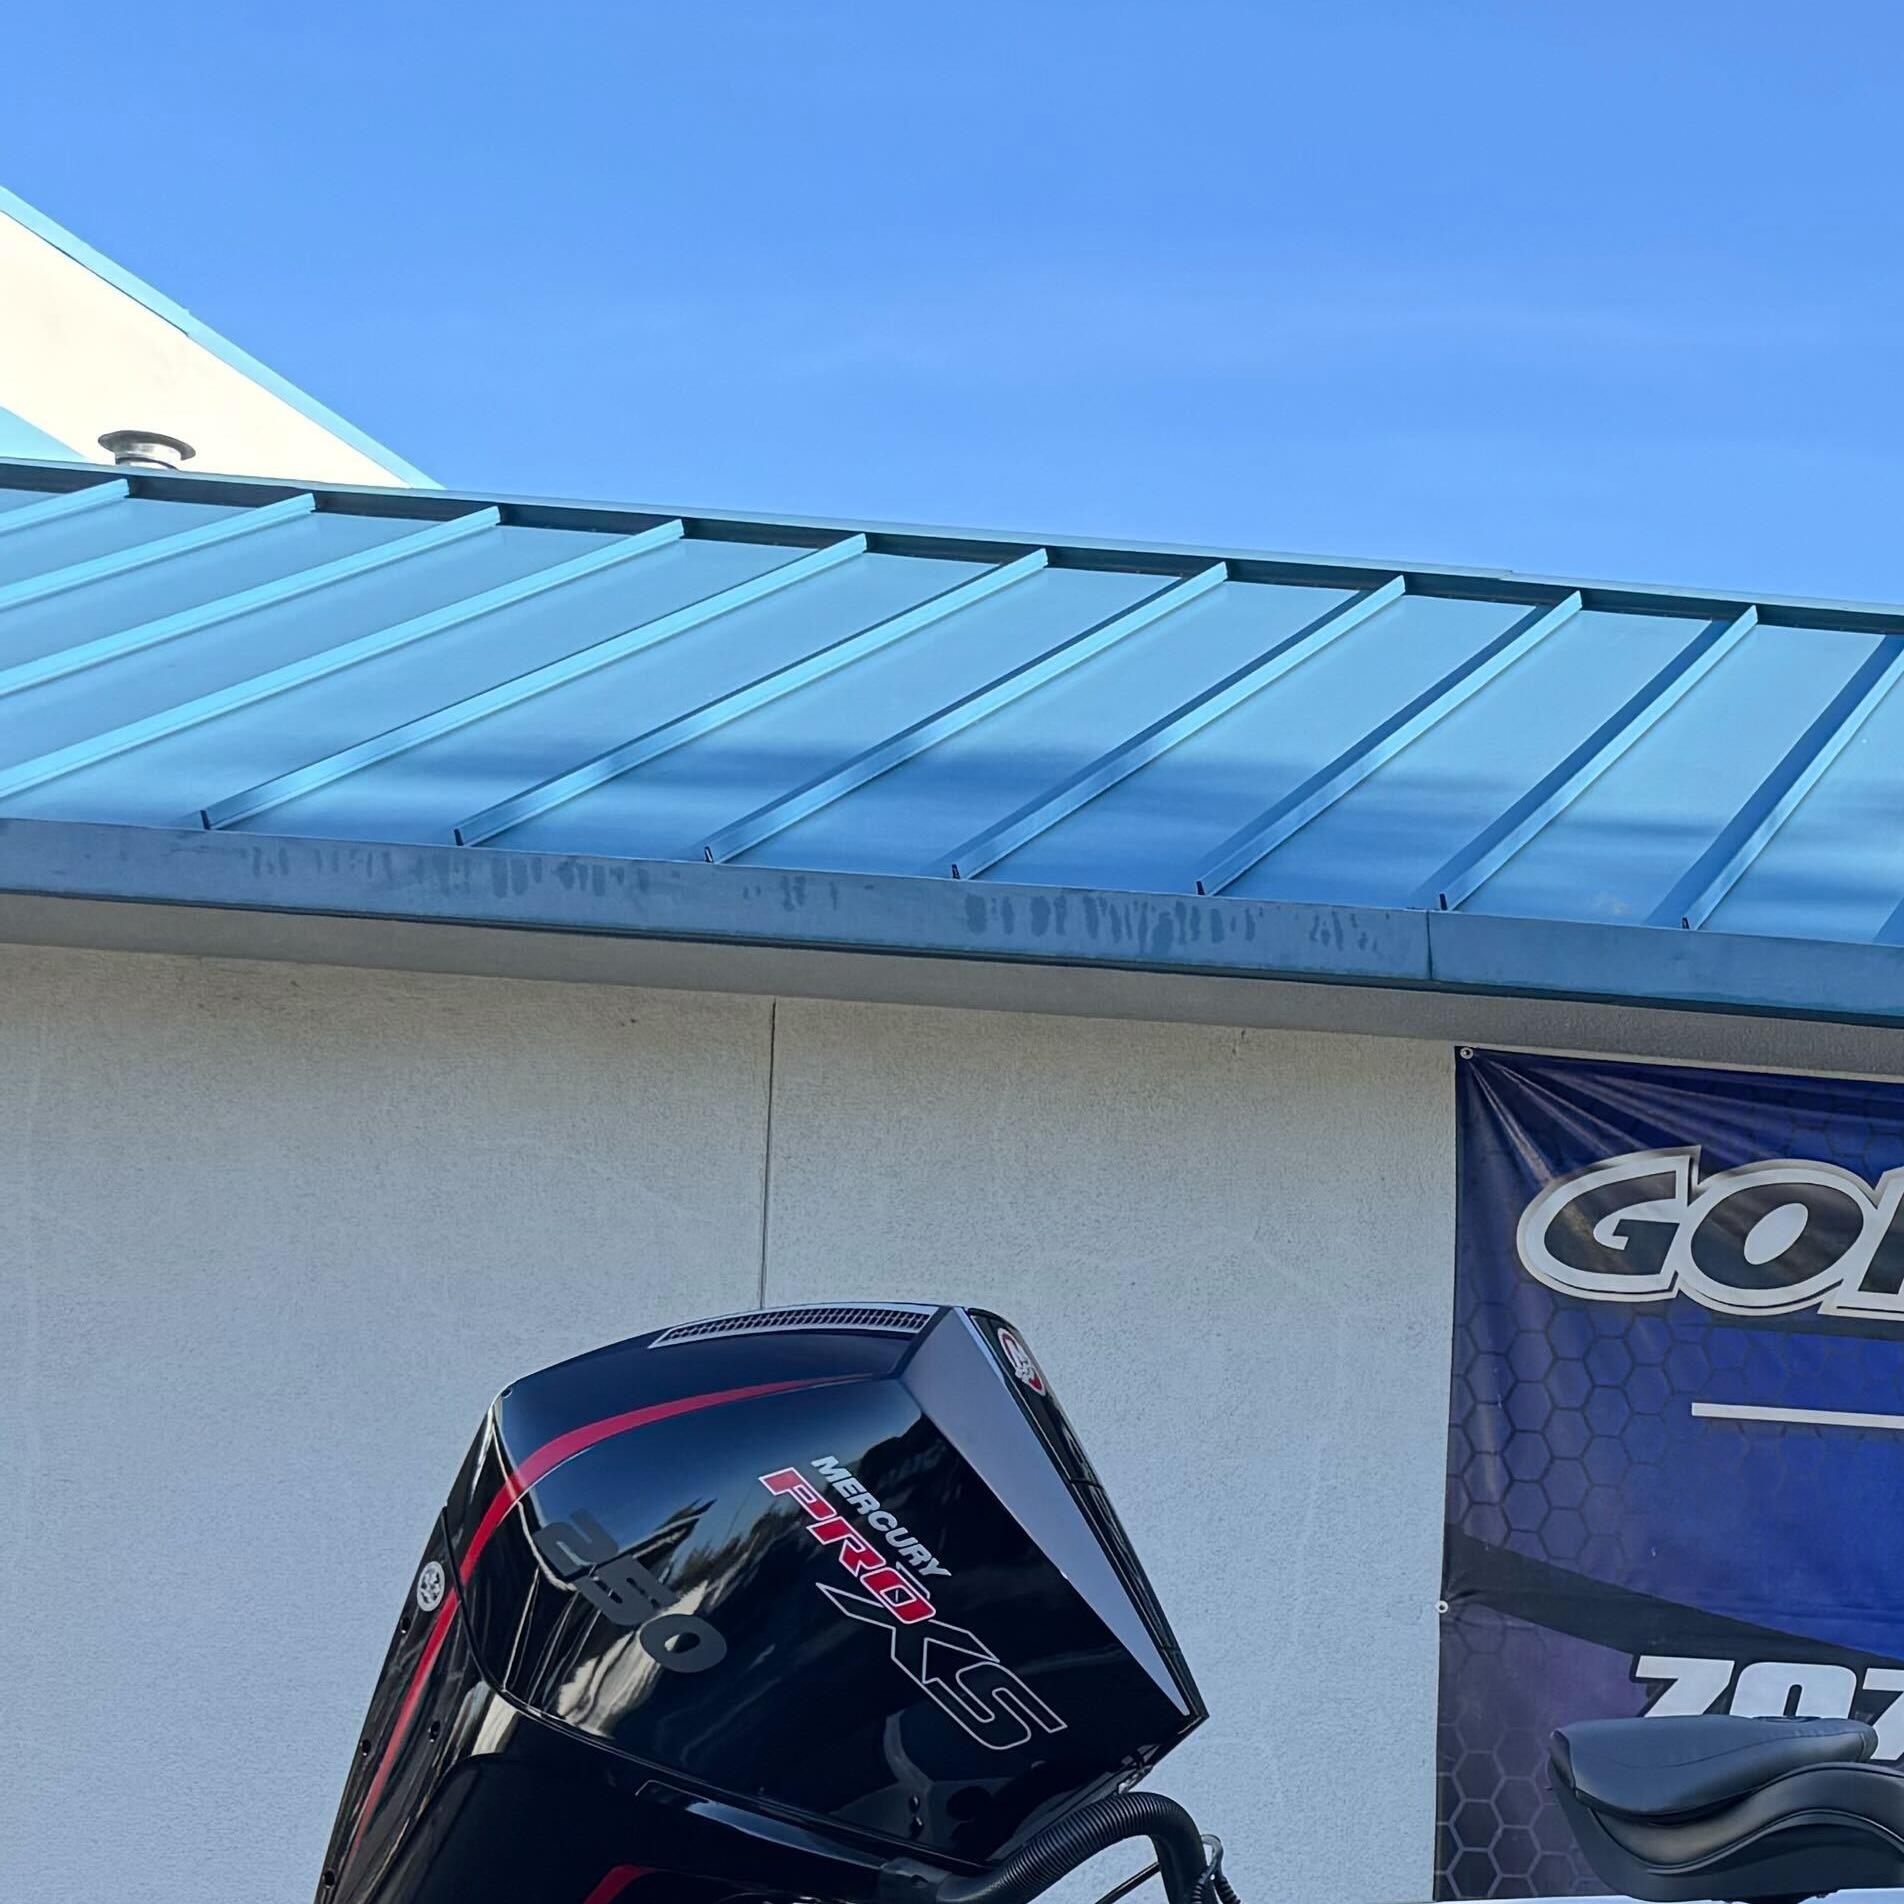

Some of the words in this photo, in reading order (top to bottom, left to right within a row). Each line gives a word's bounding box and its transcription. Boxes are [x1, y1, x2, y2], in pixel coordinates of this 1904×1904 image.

[532, 1508, 728, 1673] 250
[759, 1467, 936, 1624] PRO
[811, 1456, 951, 1577] MERCURY
[815, 1561, 1068, 1750] XS
